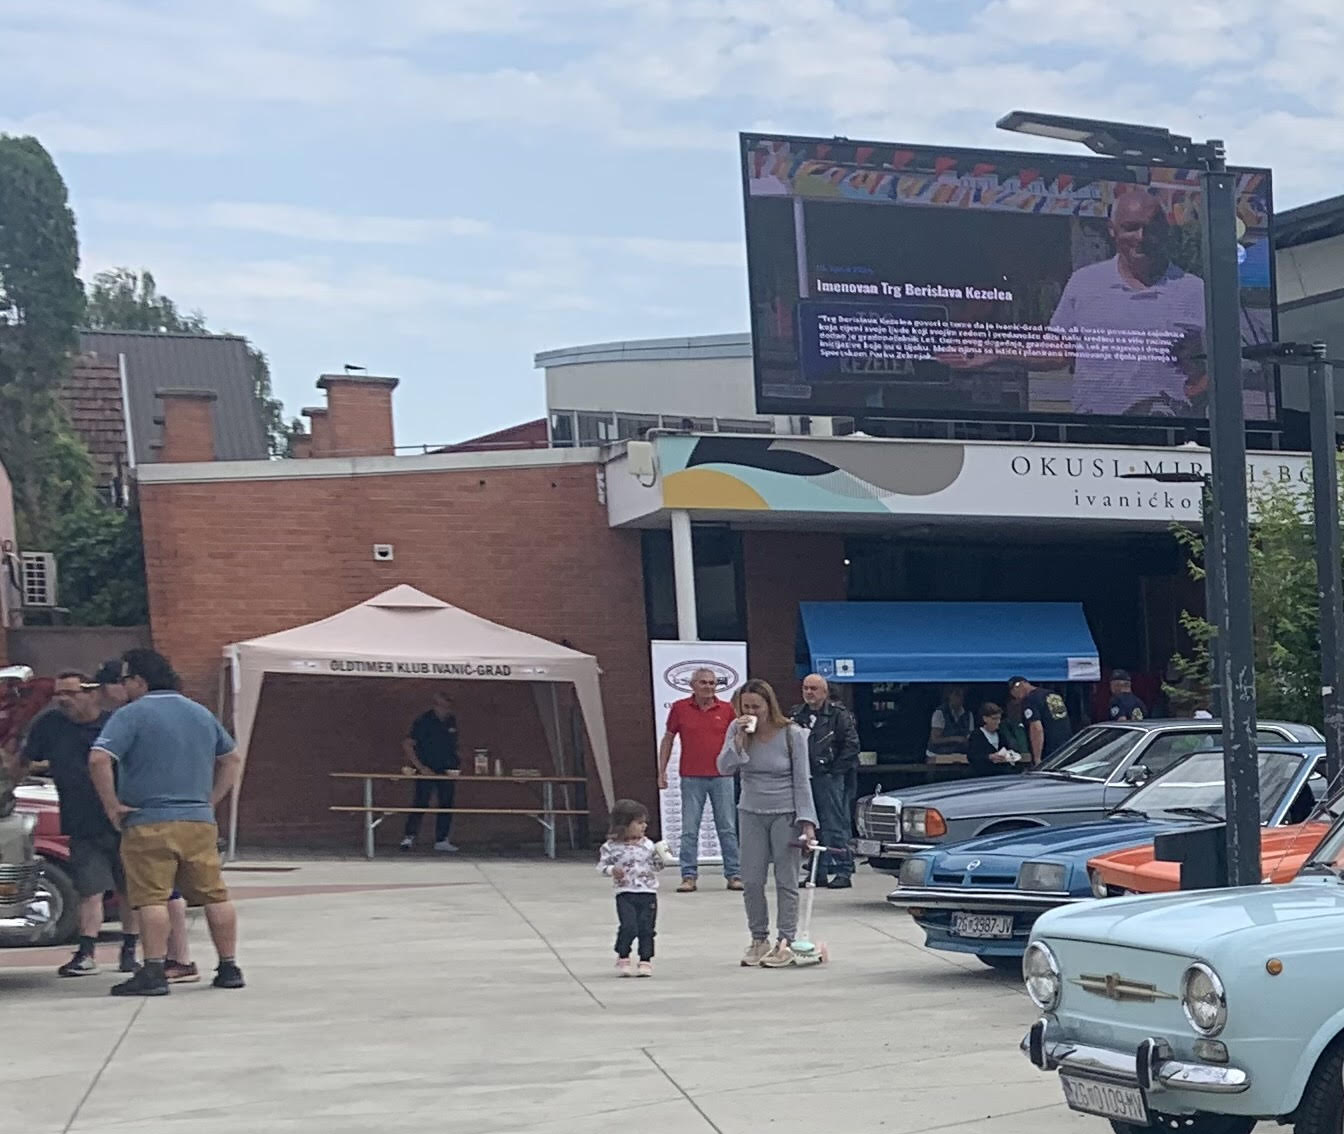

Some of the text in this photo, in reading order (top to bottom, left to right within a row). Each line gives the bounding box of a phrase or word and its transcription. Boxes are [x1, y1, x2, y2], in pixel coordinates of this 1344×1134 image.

[817, 279, 1013, 301] Imenovan Trg Berislava Kezelea
[1073, 489, 1204, 510] ivanićko
[330, 660, 394, 673] OLDTIMER
[397, 662, 429, 674] KLUB
